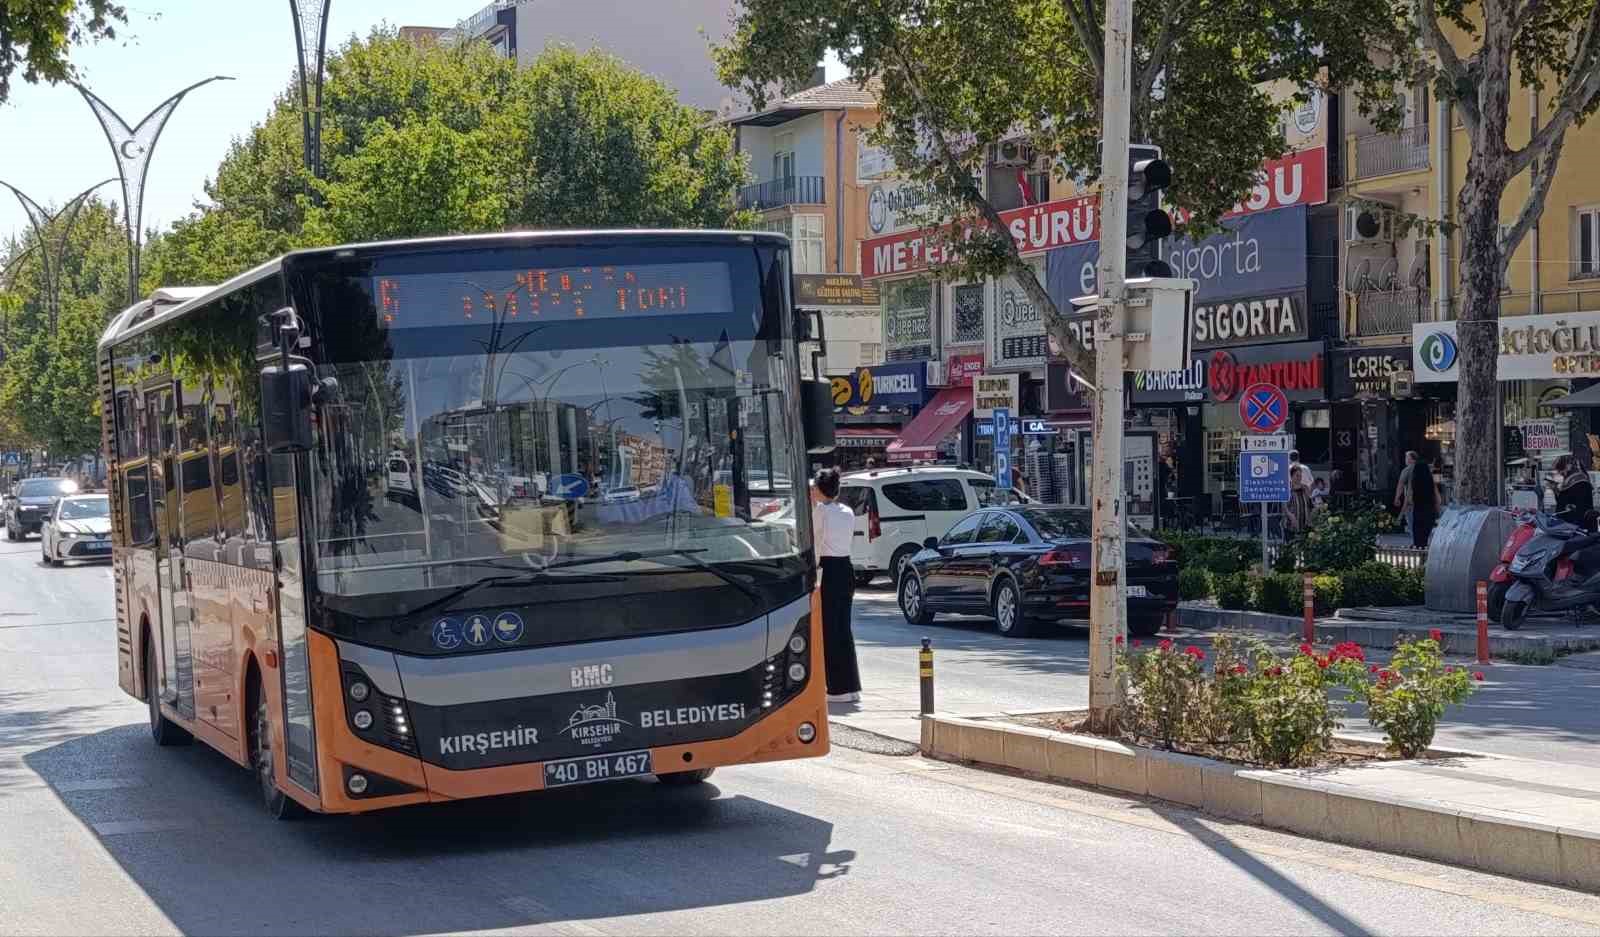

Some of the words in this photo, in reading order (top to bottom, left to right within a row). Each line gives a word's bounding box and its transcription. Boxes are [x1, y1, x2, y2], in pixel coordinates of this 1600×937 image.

[1009, 199, 1094, 249] SÜRÜ
[1170, 230, 1261, 294] sigorta
[872, 374, 918, 394] TURKCELL
[1146, 360, 1203, 391] BARGELLO
[1253, 439, 1267, 447] 125
[1528, 424, 1556, 436] ALANA
[1528, 437, 1560, 449] BEDAVA
[571, 663, 614, 688] BMC
[439, 727, 538, 756] KIRŞEHİR
[555, 763, 578, 782] 40
[586, 759, 609, 779] BH
[615, 754, 649, 774] 467
